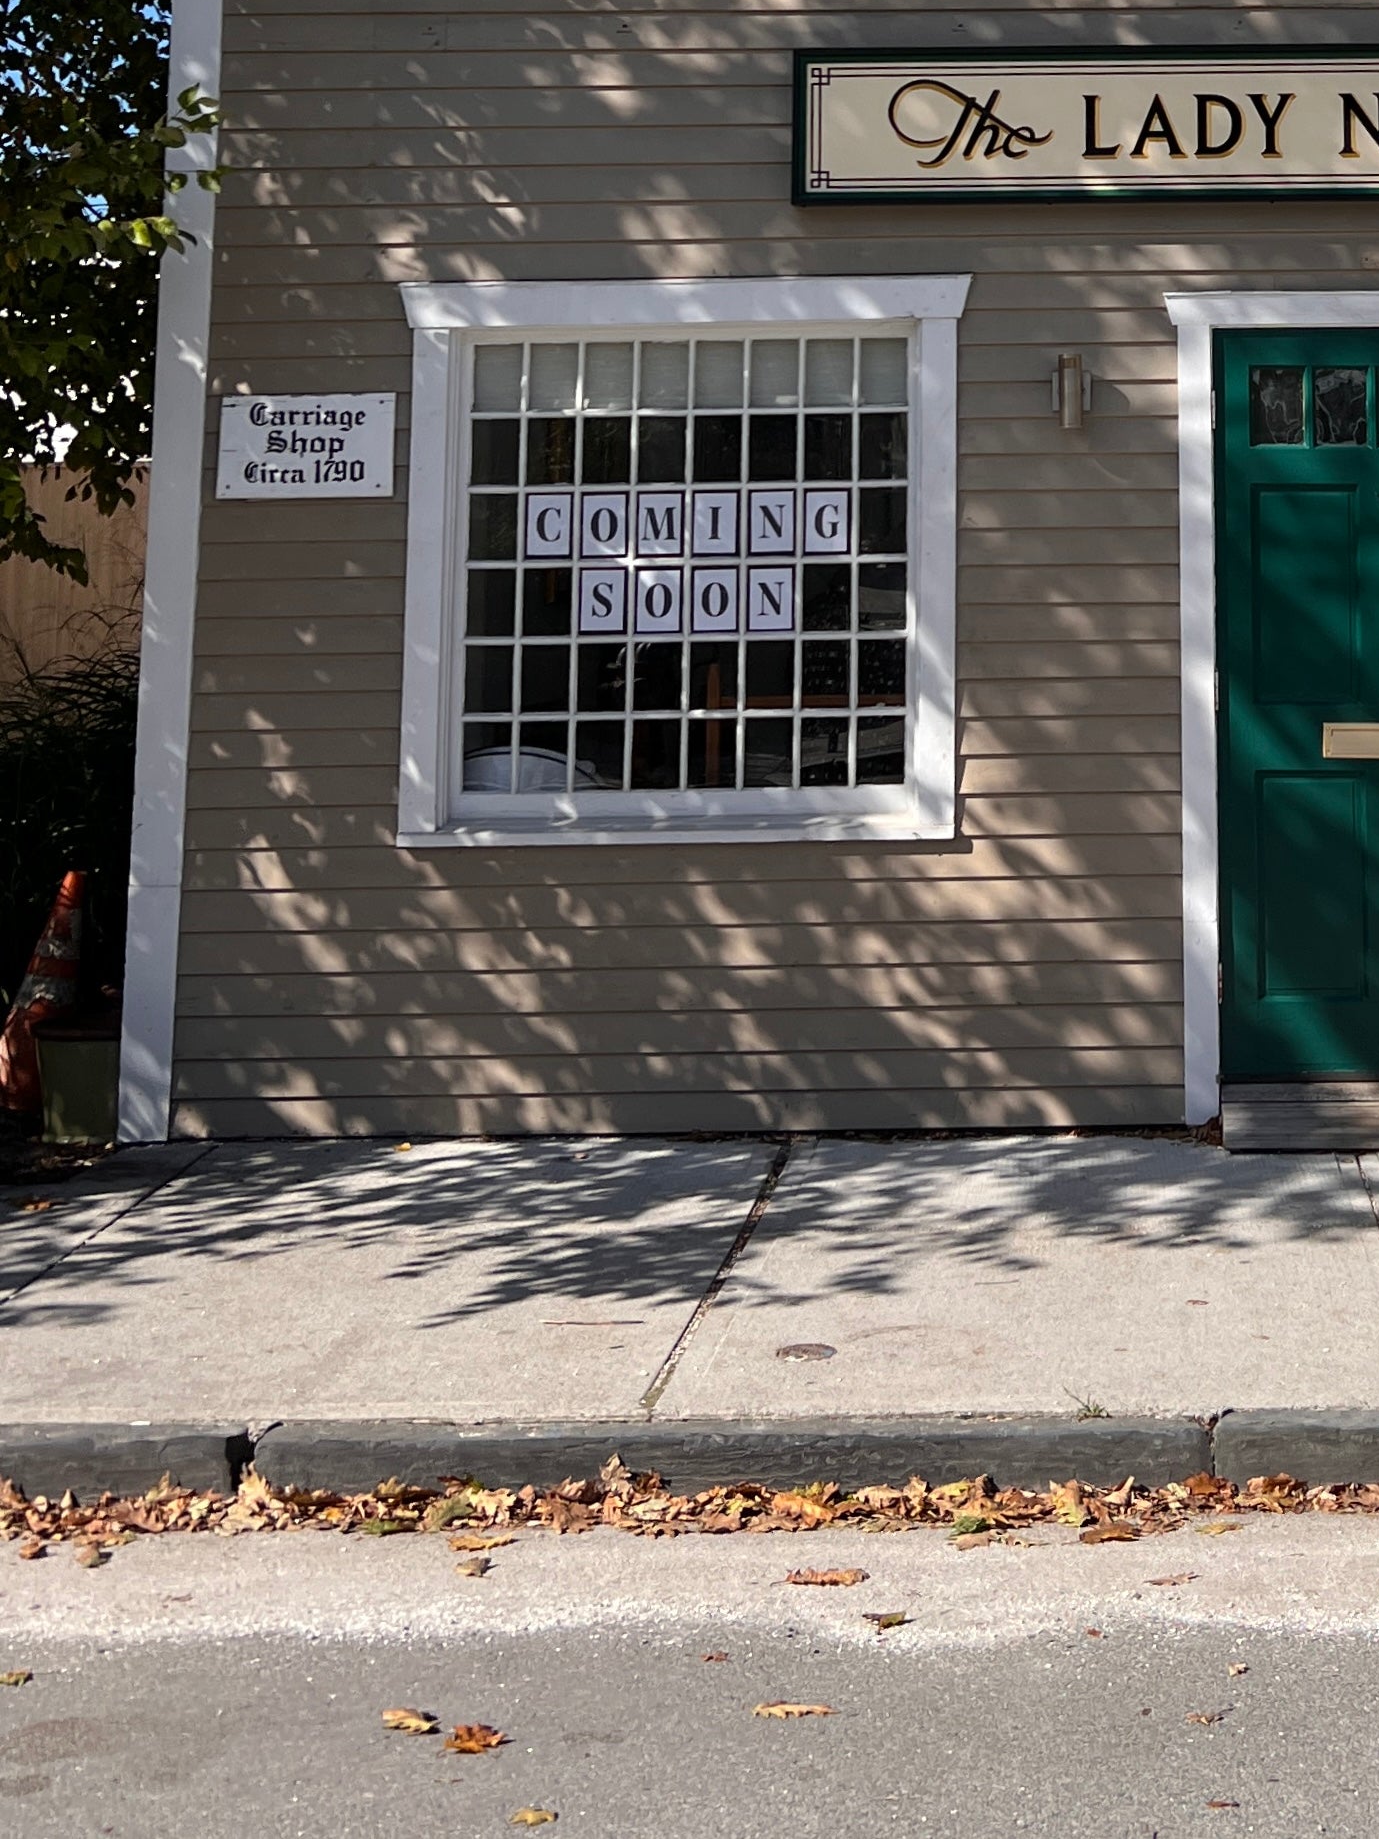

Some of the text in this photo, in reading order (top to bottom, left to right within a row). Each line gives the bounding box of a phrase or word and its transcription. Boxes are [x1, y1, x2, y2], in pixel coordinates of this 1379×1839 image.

[888, 79, 1054, 169] The
[1081, 93, 1298, 160] LADY
[249, 402, 366, 432] Carriage
[265, 430, 345, 460] Shop
[244, 459, 365, 484] Circa 1790
[535, 503, 840, 543] COMING
[591, 581, 784, 618] SOON
